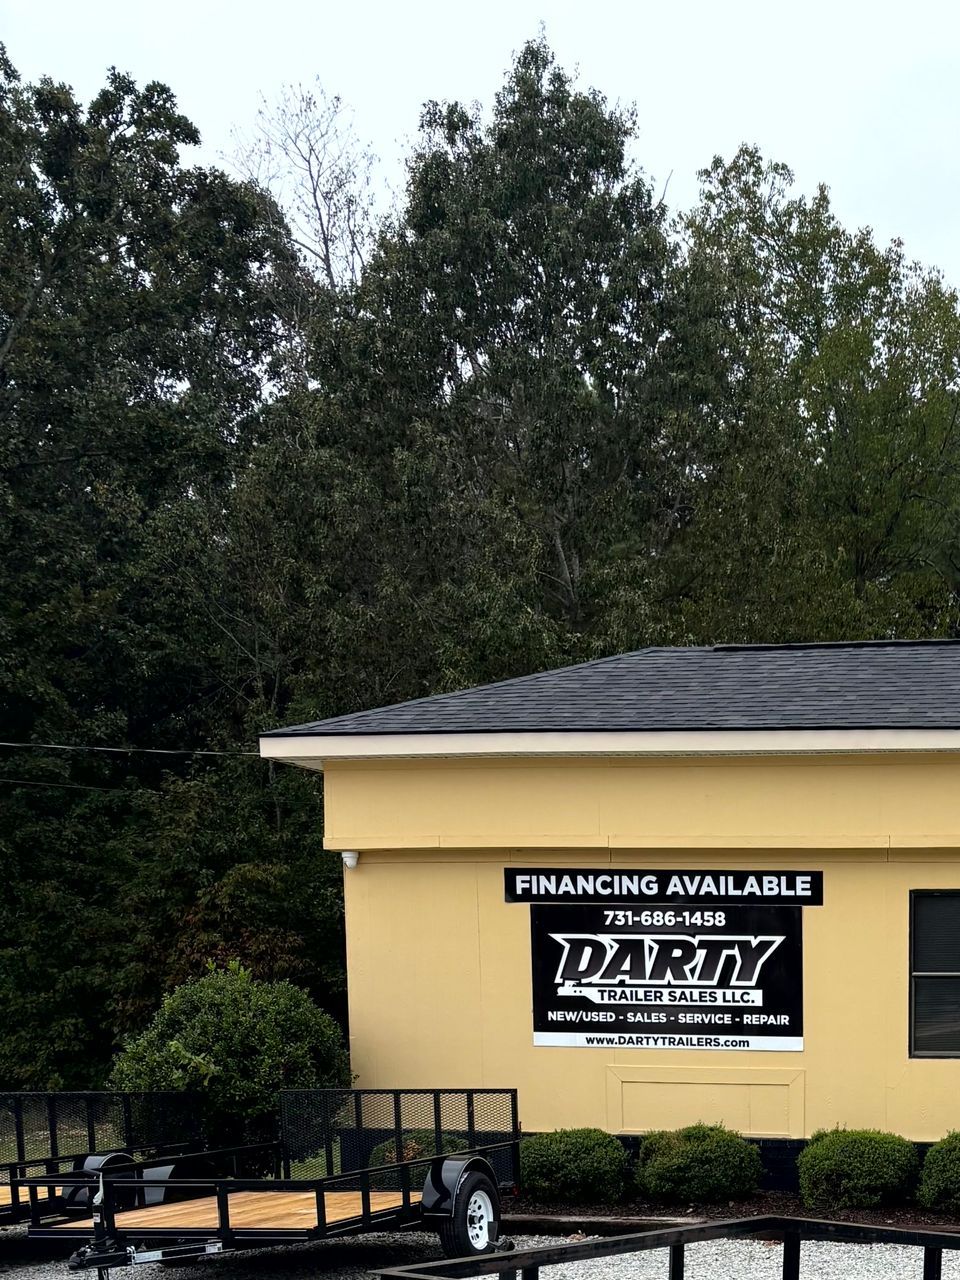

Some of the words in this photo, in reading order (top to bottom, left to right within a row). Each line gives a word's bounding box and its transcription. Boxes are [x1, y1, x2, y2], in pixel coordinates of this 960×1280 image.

[515, 874, 658, 896] FINANCING
[666, 875, 812, 896] AVAILABLE
[603, 910, 726, 927] 731-686-1458
[548, 932, 787, 987] DARTY
[597, 989, 664, 1003] TRAILER
[667, 990, 718, 1003] SALES
[722, 991, 755, 1004] LLC.
[547, 1010, 616, 1024] NEW/USED
[626, 1011, 667, 1024] SALES
[678, 1012, 732, 1025] SERVICE
[743, 1013, 790, 1026] REPAIR
[585, 1035, 750, 1048] www.DARTYTRAILERS.com
